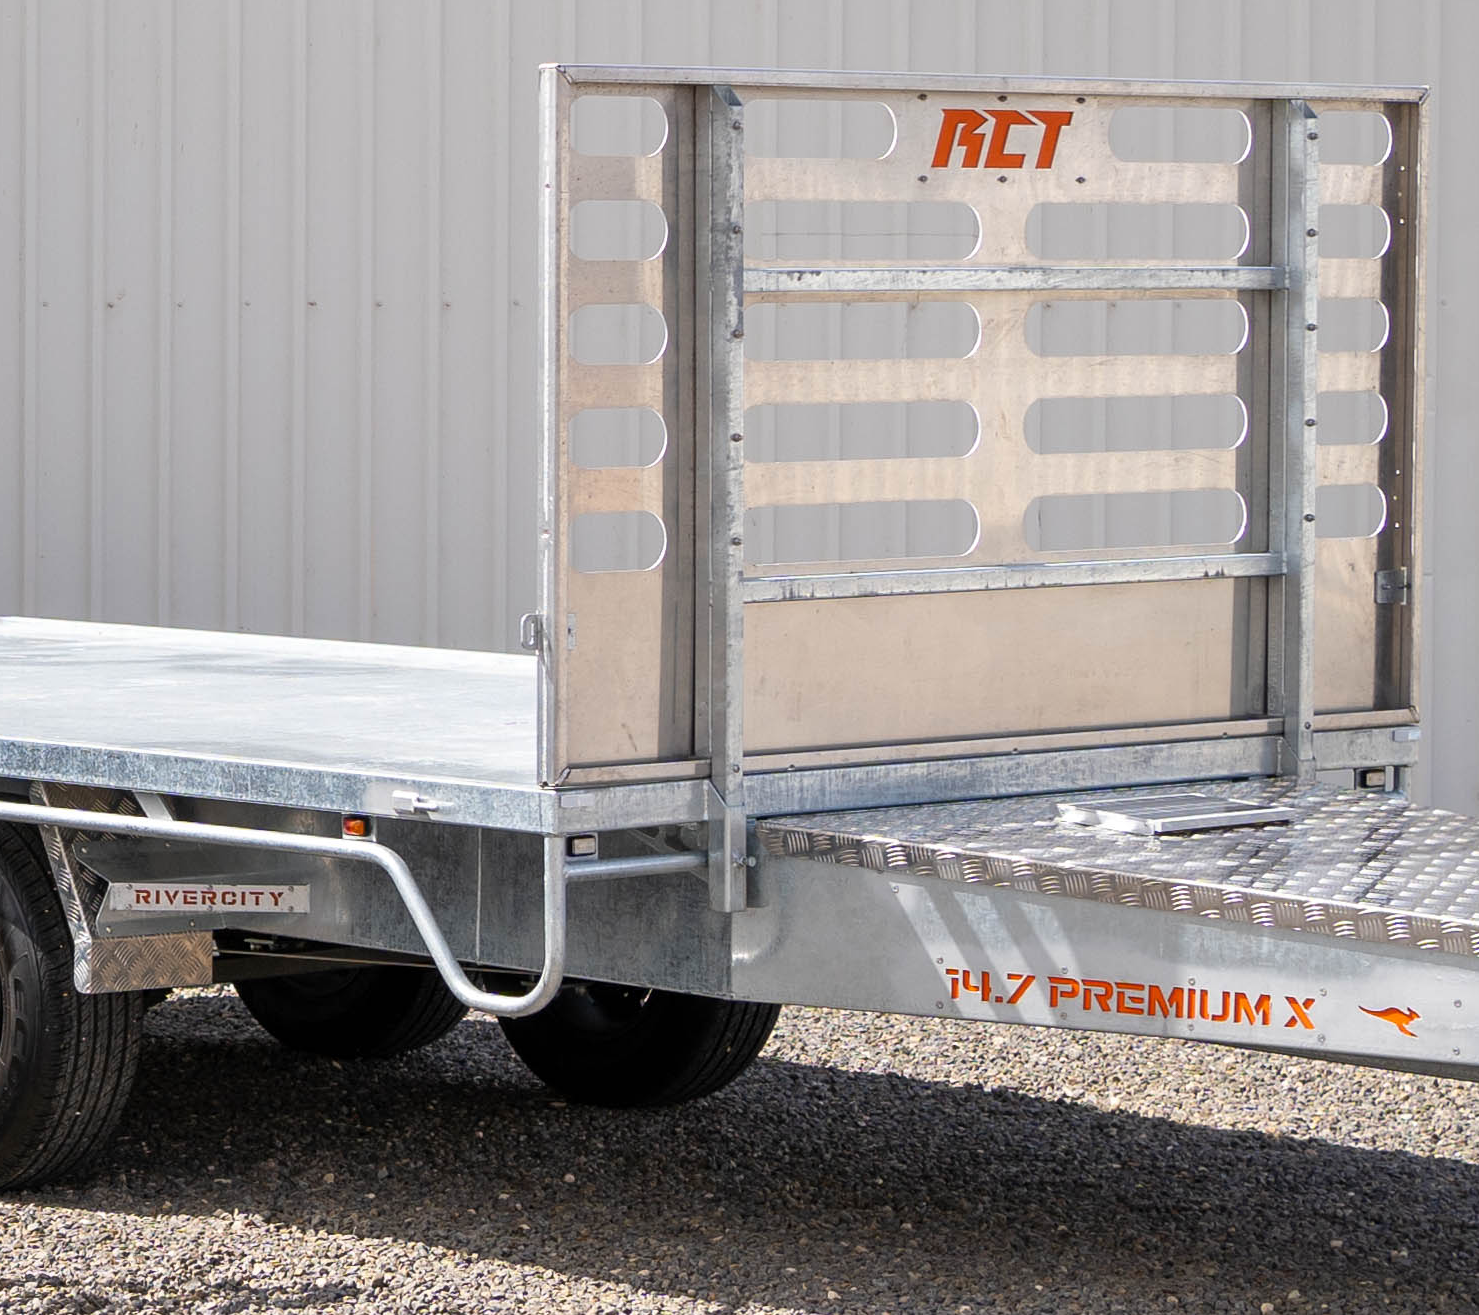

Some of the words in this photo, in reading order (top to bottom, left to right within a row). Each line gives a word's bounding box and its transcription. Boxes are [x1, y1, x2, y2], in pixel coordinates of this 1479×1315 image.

[930, 108, 1074, 170] RCT
[134, 889, 285, 907] RIVERCITY
[1047, 975, 1272, 1026] PREMIUM
[1283, 994, 1316, 1030] X
